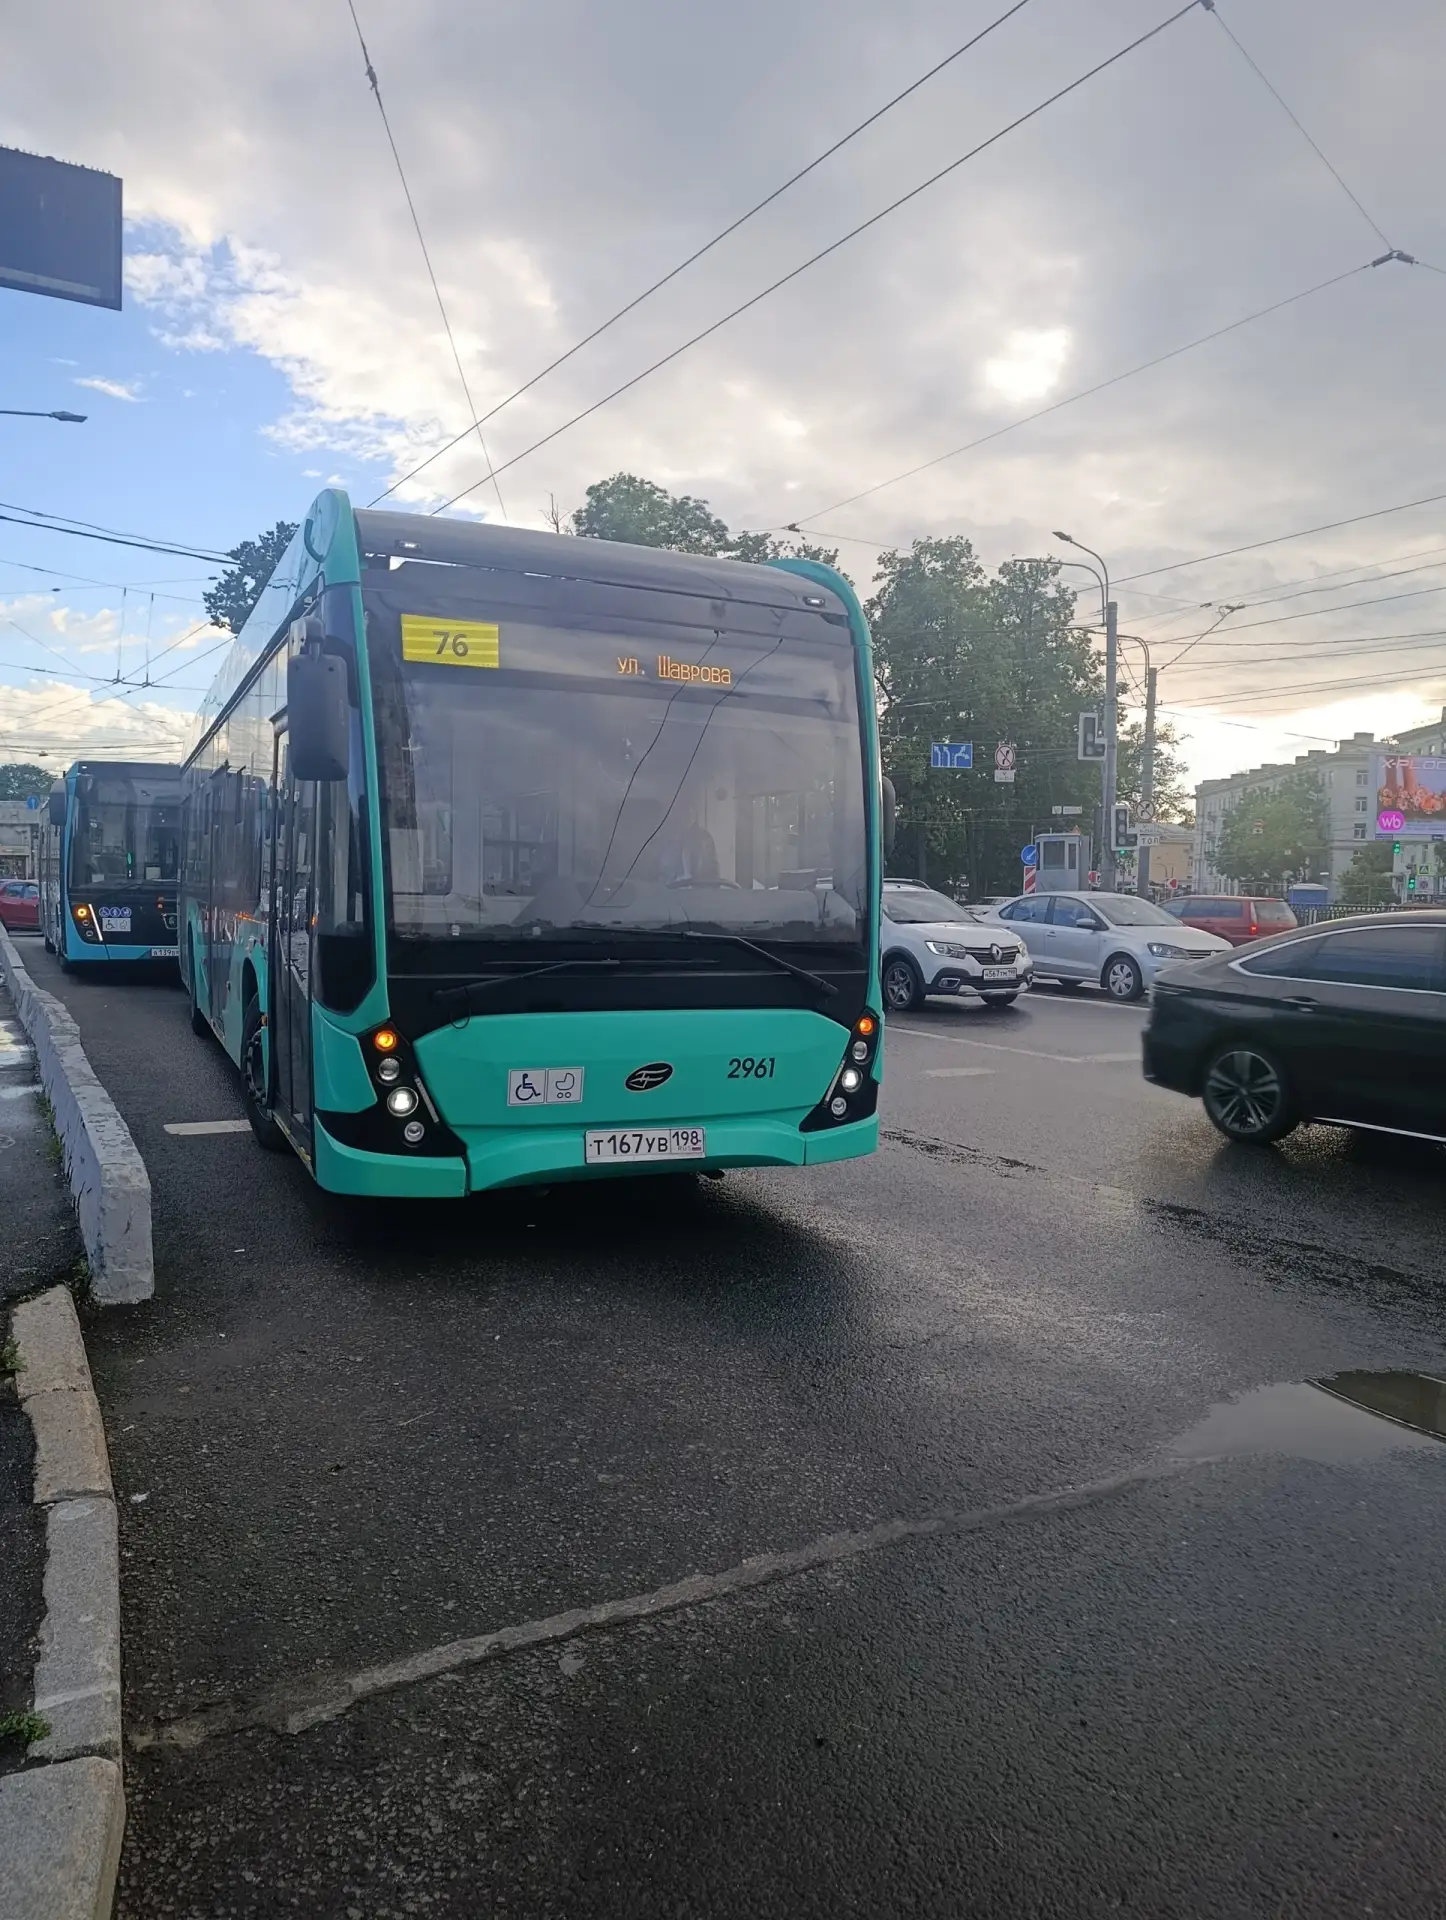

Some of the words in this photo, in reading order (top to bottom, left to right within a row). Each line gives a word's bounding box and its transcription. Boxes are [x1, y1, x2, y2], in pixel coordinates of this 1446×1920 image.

[432, 630, 469, 658] 76
[616, 656, 646, 676] ул.
[658, 655, 731, 684] Шаврова
[1381, 814, 1401, 829] wb
[1141, 837, 1159, 845] ТОП
[727, 1057, 775, 1079] 2961
[593, 1133, 668, 1155] Т167УВ
[672, 1130, 699, 1147] 198
